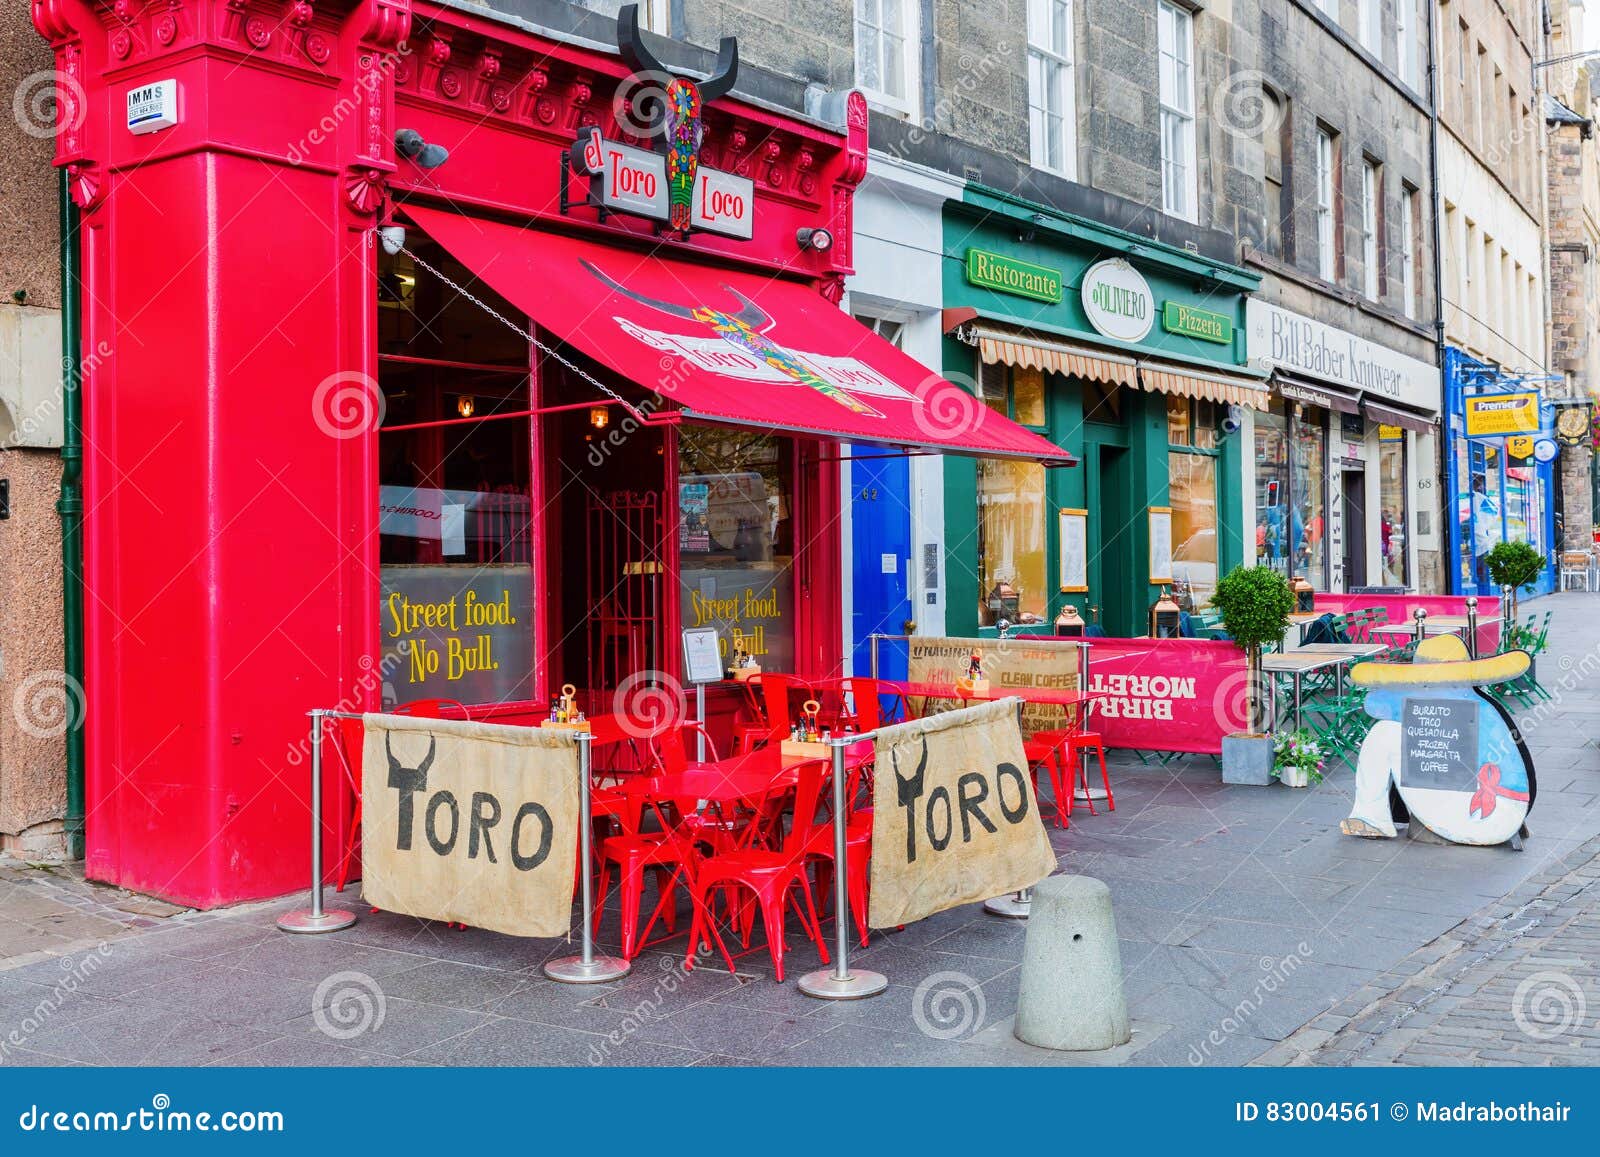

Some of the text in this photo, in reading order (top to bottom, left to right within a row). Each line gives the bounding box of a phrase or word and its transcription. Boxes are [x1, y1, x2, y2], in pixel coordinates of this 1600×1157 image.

[584, 131, 604, 169] el
[609, 151, 656, 198] Toro
[701, 175, 744, 221] Loco
[976, 253, 1057, 297] Ristorante
[1177, 307, 1222, 337] Pizzeria
[1271, 311, 1402, 396] Bill Baber Knitwear
[1478, 400, 1518, 411] Premier
[1418, 479, 1431, 490] 68
[388, 590, 516, 638] Street food.
[691, 587, 781, 627] Street food.
[409, 635, 499, 684] No Bull.
[1001, 671, 1078, 688] CLEAN COFFEE
[1412, 705, 1451, 716] BURRITO
[1418, 717, 1441, 727] TACO
[1407, 727, 1459, 739] QUESADILLA
[1417, 740, 1450, 750] FROZEN
[1410, 749, 1460, 761] MARGARITA
[1420, 761, 1449, 772] COFFEE
[386, 729, 553, 872] TORO
[893, 733, 1029, 864] TORO
